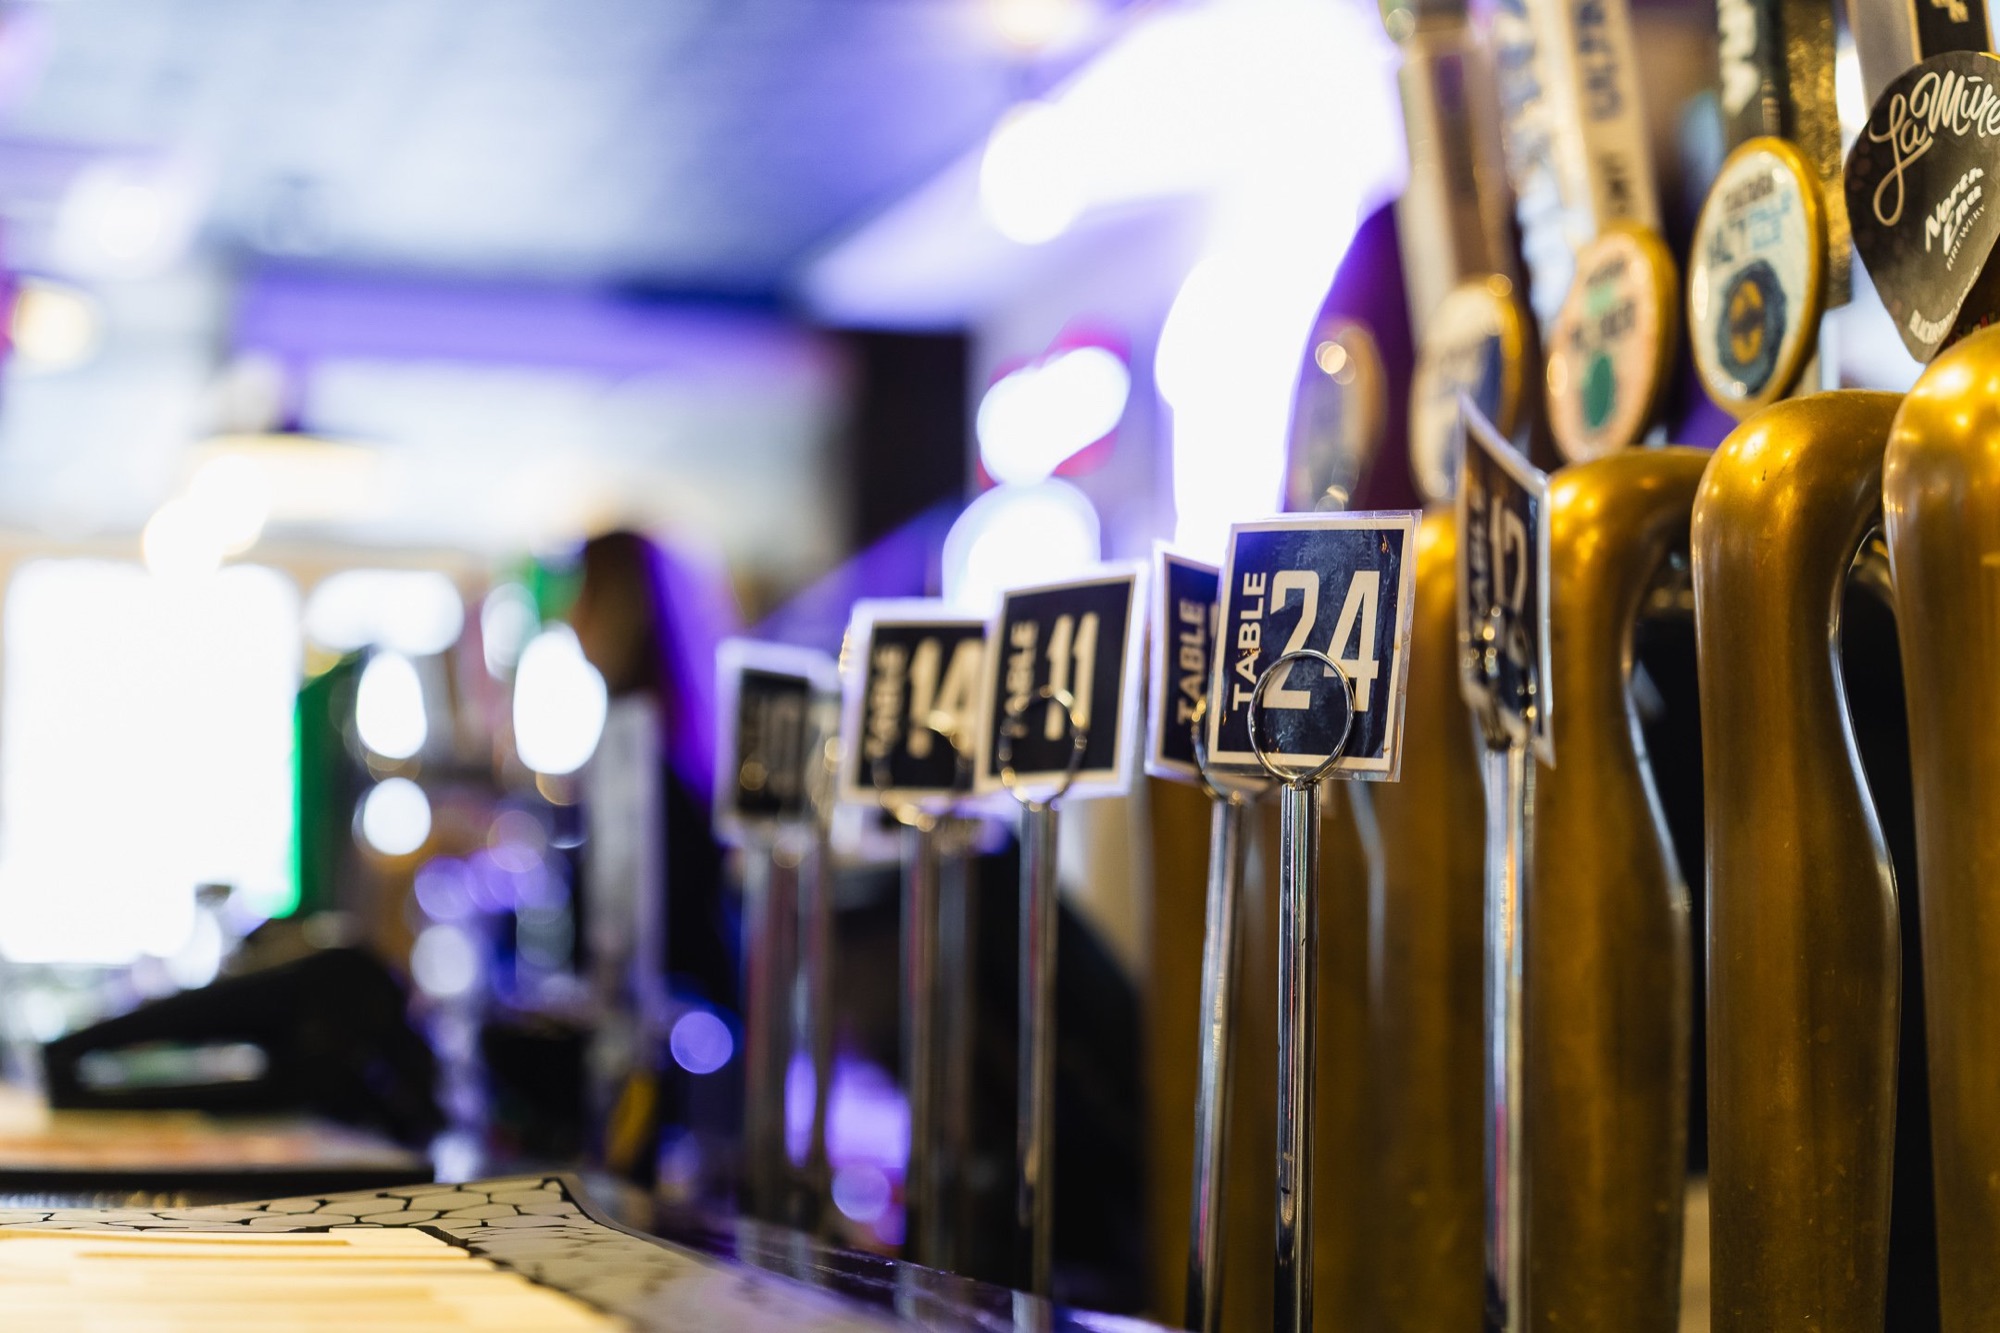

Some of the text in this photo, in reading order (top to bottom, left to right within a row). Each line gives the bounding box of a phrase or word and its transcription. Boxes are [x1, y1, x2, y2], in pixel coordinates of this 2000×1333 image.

[1868, 93, 1934, 227] La
[906, 636, 985, 760] 14
[1044, 611, 1100, 742] 11
[1176, 597, 1207, 725] TABLE
[1232, 572, 1267, 711] TABLE
[1262, 569, 1381, 712] 24
